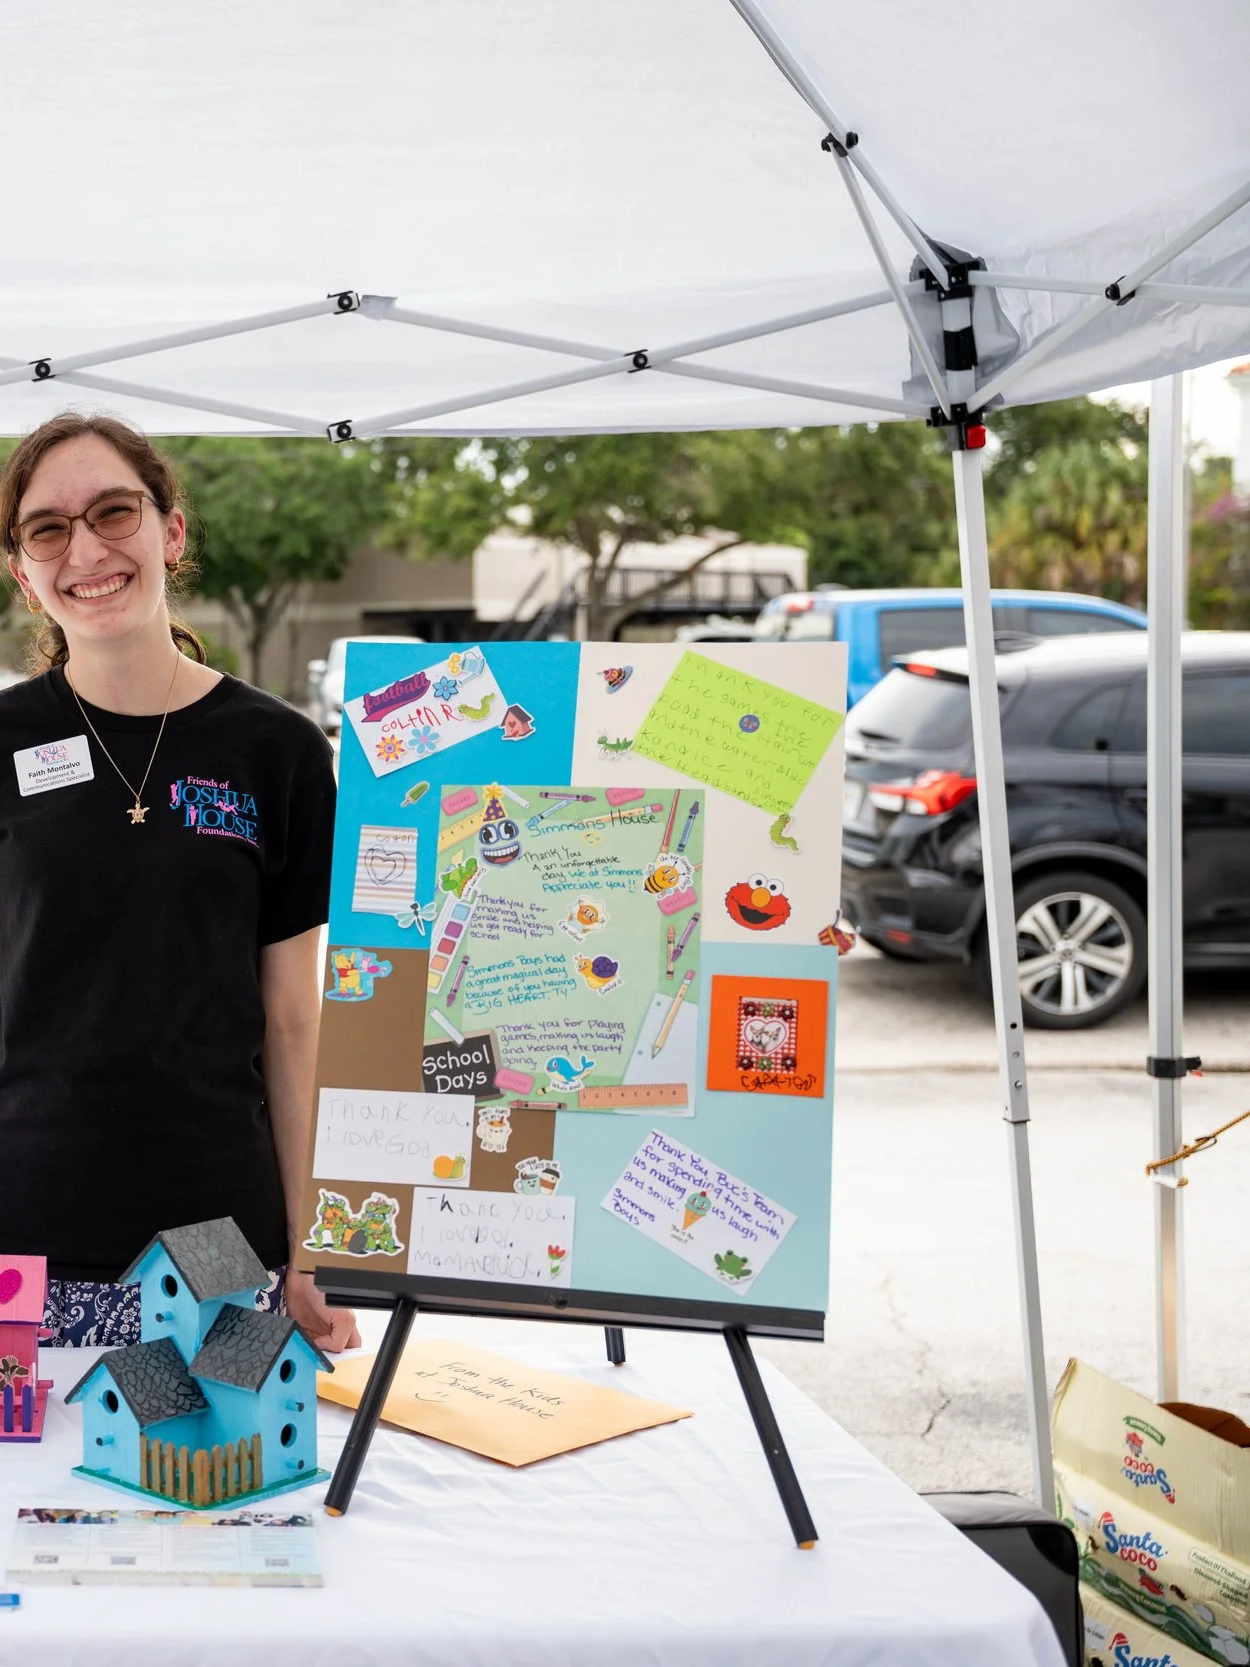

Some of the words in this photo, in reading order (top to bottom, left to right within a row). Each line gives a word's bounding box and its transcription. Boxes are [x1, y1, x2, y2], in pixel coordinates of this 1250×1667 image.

[28, 769, 46, 779] Faith
[47, 761, 81, 774] Montalvo
[35, 771, 70, 784] Development
[23, 779, 66, 793] Communications
[66, 772, 90, 783] Specialist
[187, 776, 218, 787] Friends
[219, 781, 230, 790] of
[170, 780, 258, 816] JOSHUA
[182, 804, 257, 841] HOUSE
[528, 820, 605, 838] Simmons
[611, 809, 659, 827] House
[523, 848, 562, 863] Thank
[562, 846, 581, 860] You
[560, 856, 621, 868] unforgettable
[542, 872, 567, 883] day
[602, 866, 643, 876] Simmons
[542, 881, 603, 893] Appreciate
[476, 906, 519, 921] making
[507, 900, 524, 909] you
[530, 903, 549, 912] for
[486, 923, 499, 932] get
[503, 925, 527, 939] ready
[530, 929, 545, 938] for
[502, 918, 521, 926] and
[523, 920, 554, 936] helping
[466, 959, 515, 978] Simmons
[517, 955, 543, 966] Boys
[545, 953, 566, 964] had
[466, 980, 475, 989] a
[476, 975, 501, 989] great
[502, 968, 543, 983] magical
[544, 966, 568, 978] day
[466, 989, 504, 999] because
[508, 983, 520, 993] of
[523, 983, 541, 994] you
[542, 978, 577, 990] having
[496, 1023, 535, 1033] Thank
[538, 1020, 559, 1031] you
[564, 1018, 584, 1027] for
[540, 1032, 580, 1043] making
[595, 1032, 624, 1042] laugh
[572, 1043, 590, 1052] the
[593, 1044, 622, 1055] party
[422, 1045, 491, 1075] School
[435, 1070, 487, 1093] Days
[623, 1171, 644, 1190] and
[651, 1131, 686, 1161] Thank
[690, 1154, 709, 1176] You
[753, 1193, 784, 1225] Team
[633, 1156, 647, 1170] us
[650, 1168, 687, 1200] making
[711, 1206, 726, 1220] us
[728, 1216, 758, 1242] laugh
[642, 1146, 664, 1163] for
[724, 1193, 753, 1223] time
[756, 1220, 781, 1240] with
[415, 1369, 438, 1382] at
[438, 1376, 495, 1400] Joshua
[499, 1397, 555, 1420] House
[439, 1361, 480, 1378] From
[489, 1375, 515, 1389] the
[521, 1387, 565, 1407] Kids
[1102, 1522, 1164, 1555] Santa
[1120, 1547, 1158, 1571] coco
[1114, 1645, 1178, 1667] Sant
